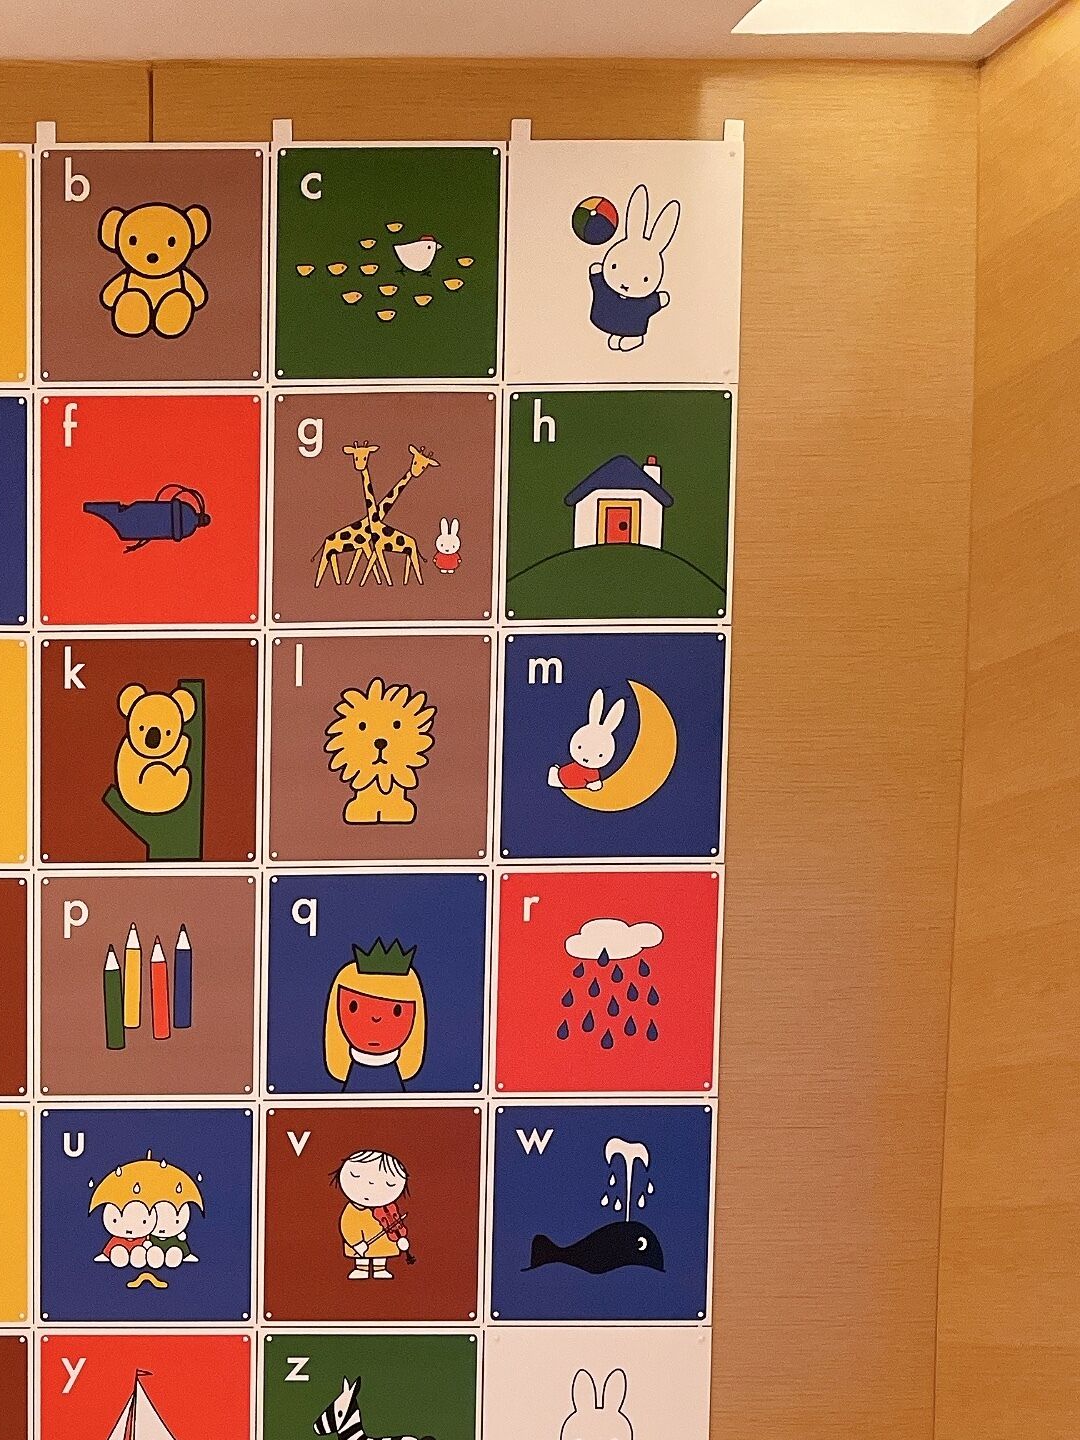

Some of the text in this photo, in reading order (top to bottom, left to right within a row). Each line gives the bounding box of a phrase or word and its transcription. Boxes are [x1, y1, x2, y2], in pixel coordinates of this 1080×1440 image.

[64, 156, 90, 202] b
[300, 172, 322, 200] c
[62, 402, 78, 447] f
[296, 416, 325, 459] g
[533, 398, 556, 443] h
[64, 645, 86, 690] k
[294, 642, 304, 687] l
[528, 657, 563, 684] m
[62, 898, 90, 940] p
[291, 898, 317, 937] q
[523, 896, 541, 922] r
[63, 1132, 85, 1158] u
[286, 1131, 312, 1157] v
[515, 1127, 554, 1155] w
[61, 1357, 87, 1394] y
[284, 1357, 310, 1382] z
